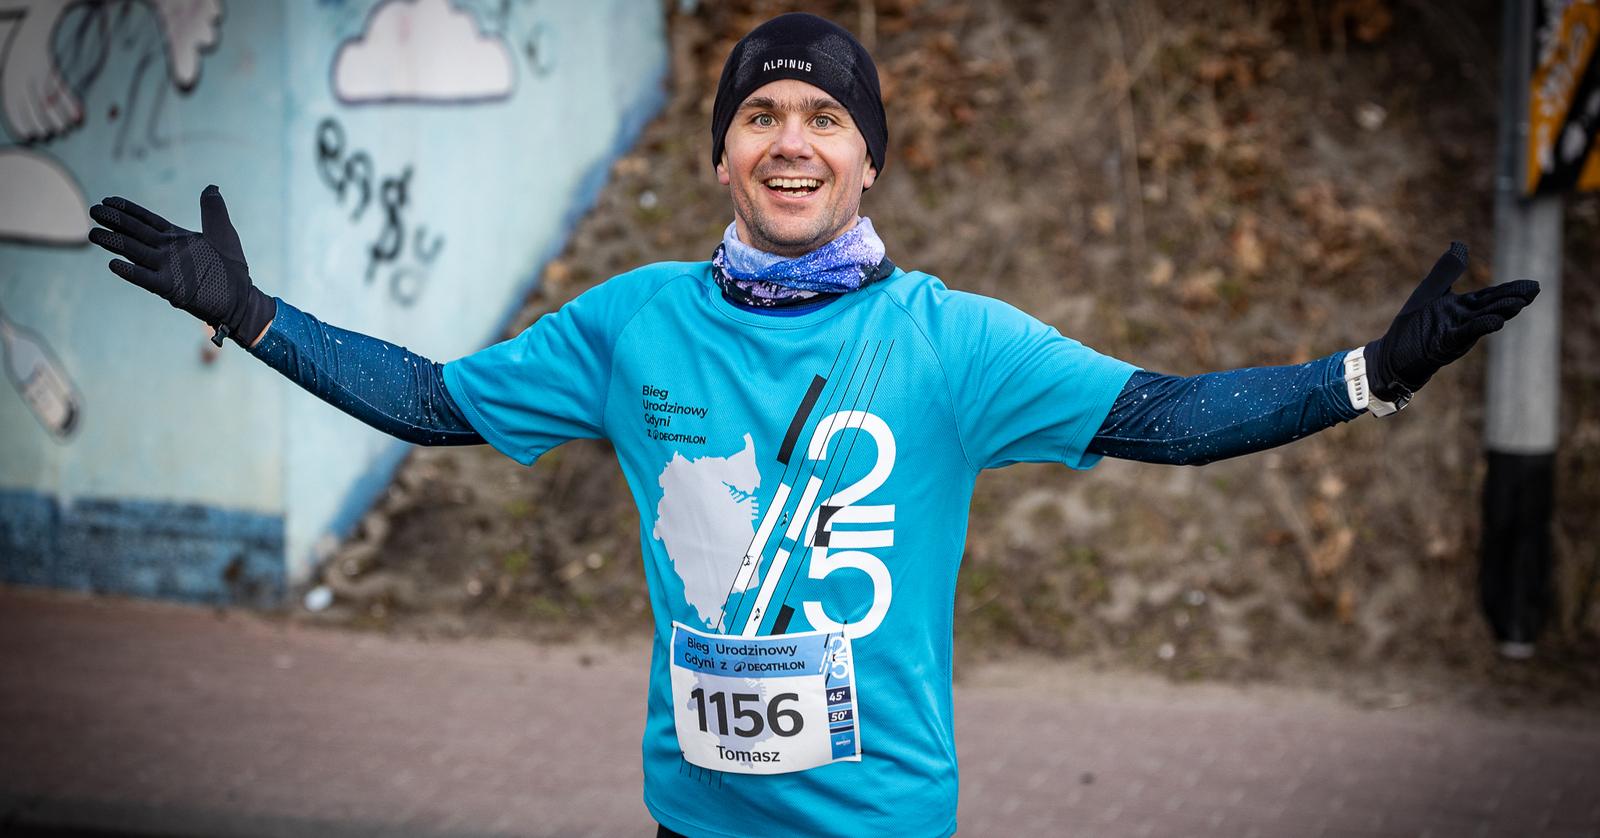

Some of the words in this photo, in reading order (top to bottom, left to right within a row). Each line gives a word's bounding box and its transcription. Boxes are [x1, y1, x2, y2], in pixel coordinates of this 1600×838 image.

[763, 58, 813, 72] ALPINUS
[642, 385, 668, 400] Bieg
[642, 399, 709, 419] Urodzinowy
[644, 413, 671, 428] Gdyni
[660, 431, 706, 444] DECATHLON
[687, 636, 710, 654] Bieg
[715, 643, 798, 657] Urodzinowy
[684, 652, 715, 669] Gdyni
[747, 660, 806, 672] DECATHLON
[691, 687, 804, 738] 1156
[716, 745, 781, 763] Tomasz
